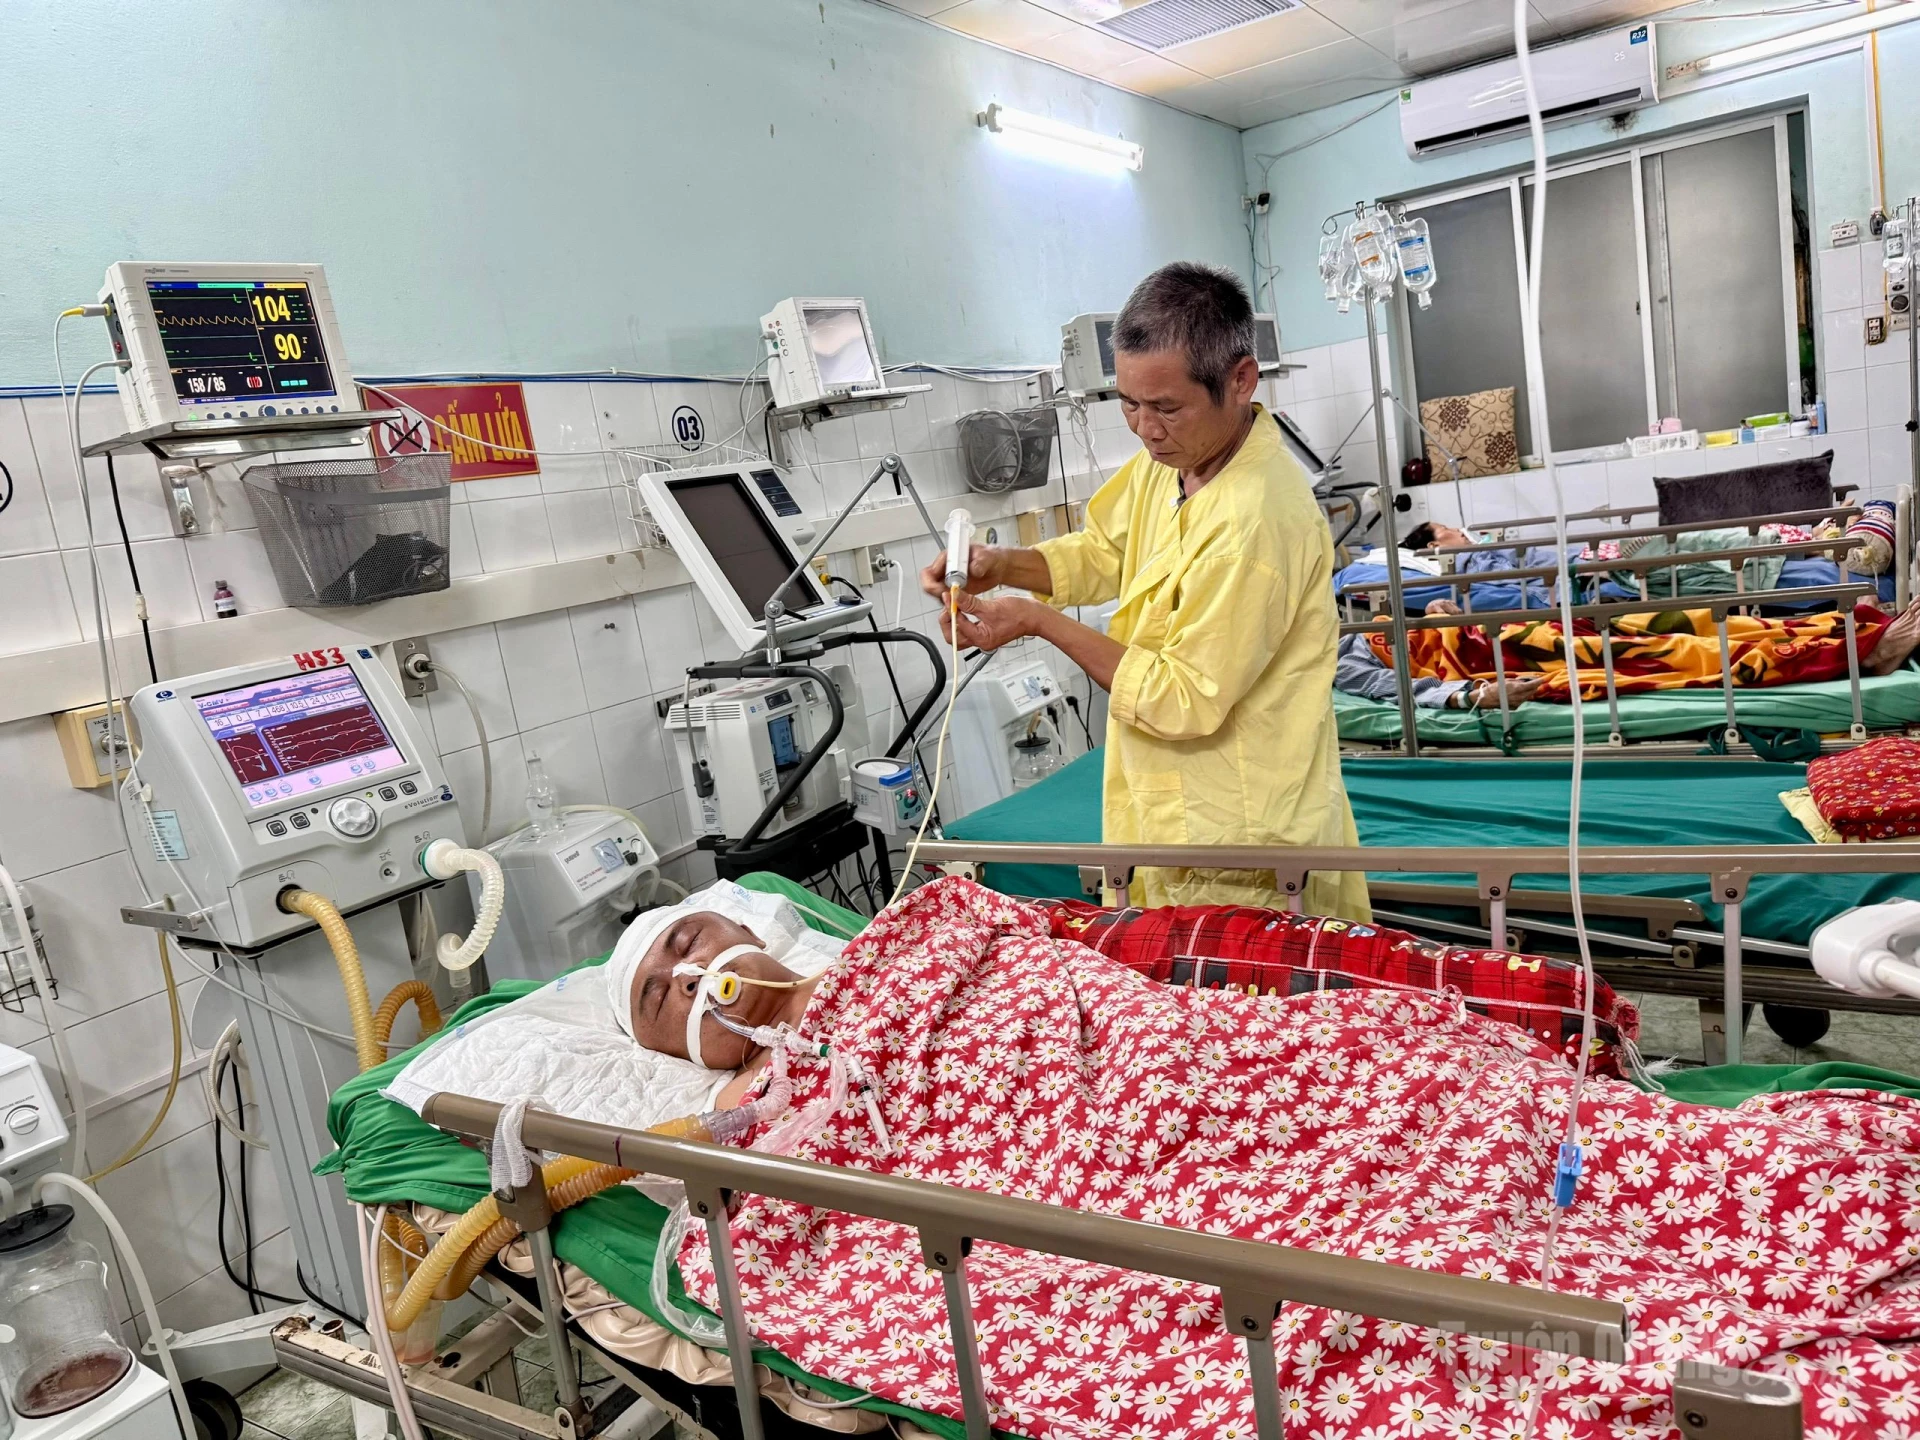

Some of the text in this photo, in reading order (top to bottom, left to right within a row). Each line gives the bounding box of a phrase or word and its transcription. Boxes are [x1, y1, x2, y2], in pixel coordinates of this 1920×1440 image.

[1632, 30, 1647, 40] R32
[253, 296, 291, 322] 104
[274, 333, 302, 360] 90
[434, 391, 529, 464] CẤM LỬA
[677, 415, 700, 441] 03
